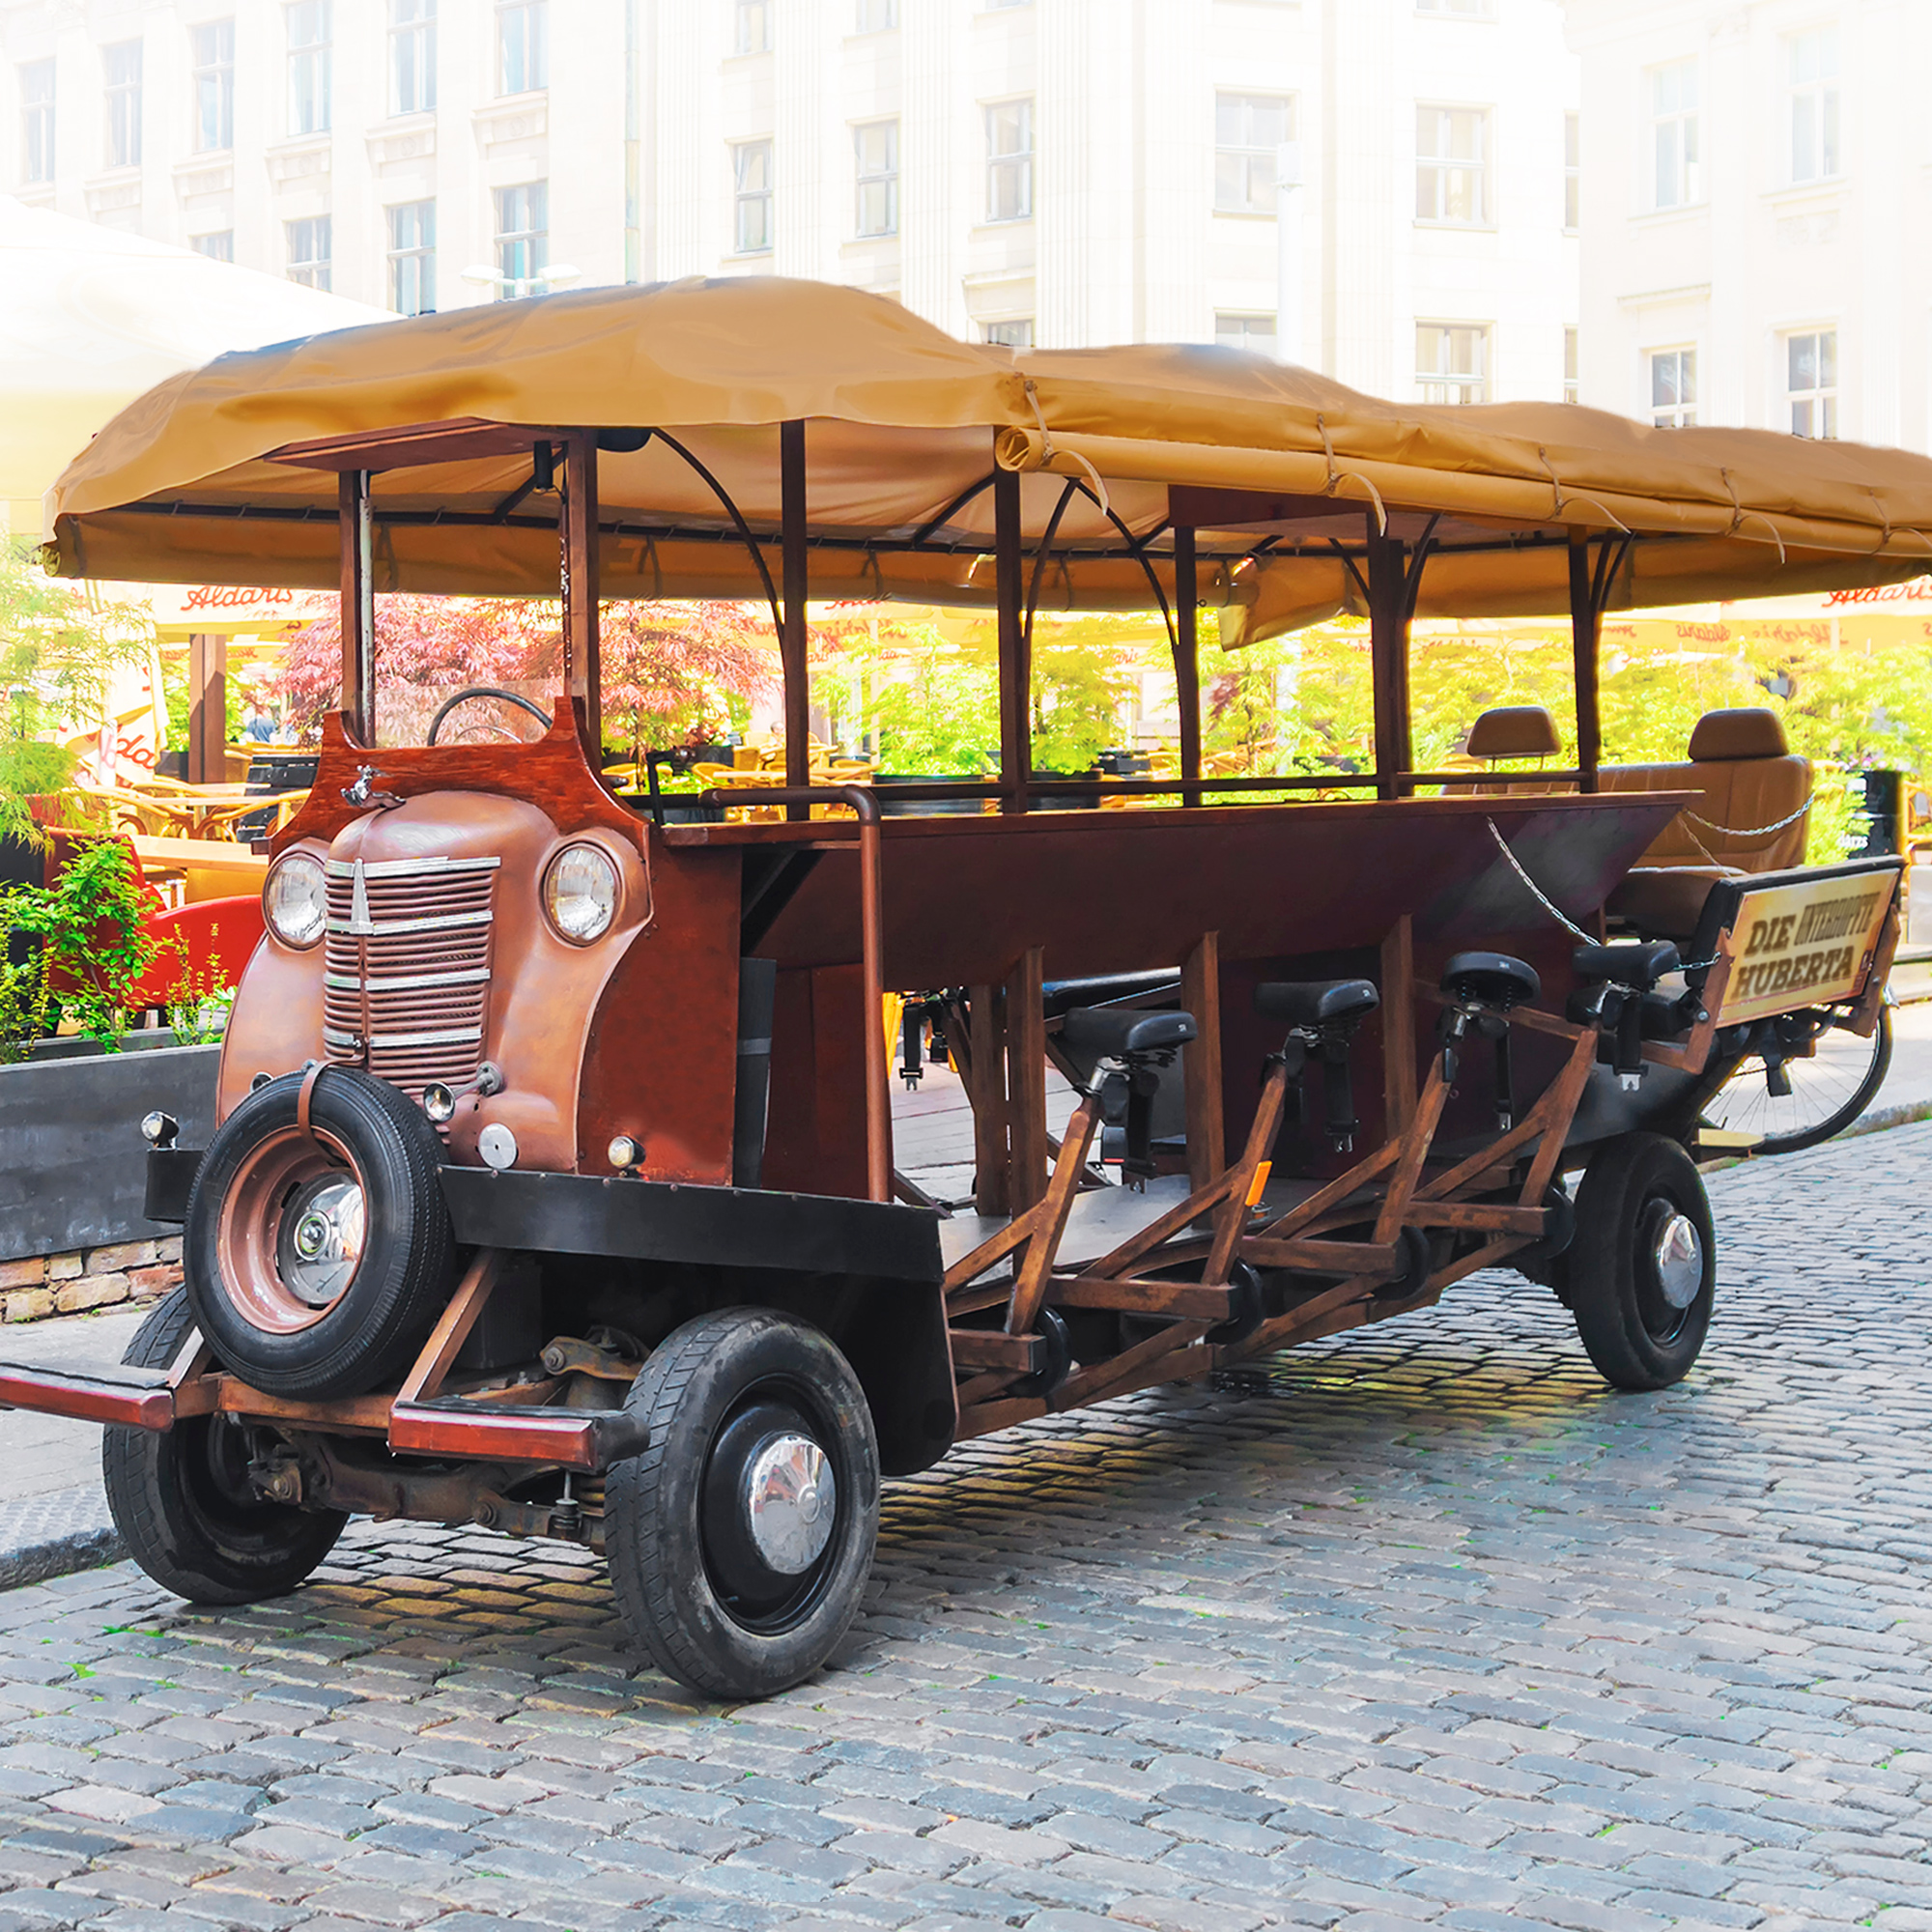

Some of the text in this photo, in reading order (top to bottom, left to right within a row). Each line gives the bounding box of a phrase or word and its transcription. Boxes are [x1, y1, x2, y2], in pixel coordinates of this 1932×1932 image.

[1821, 578, 1932, 608] Aldari
[1744, 914, 1797, 958] DIE
[1729, 945, 1855, 1001] HUBERTA
